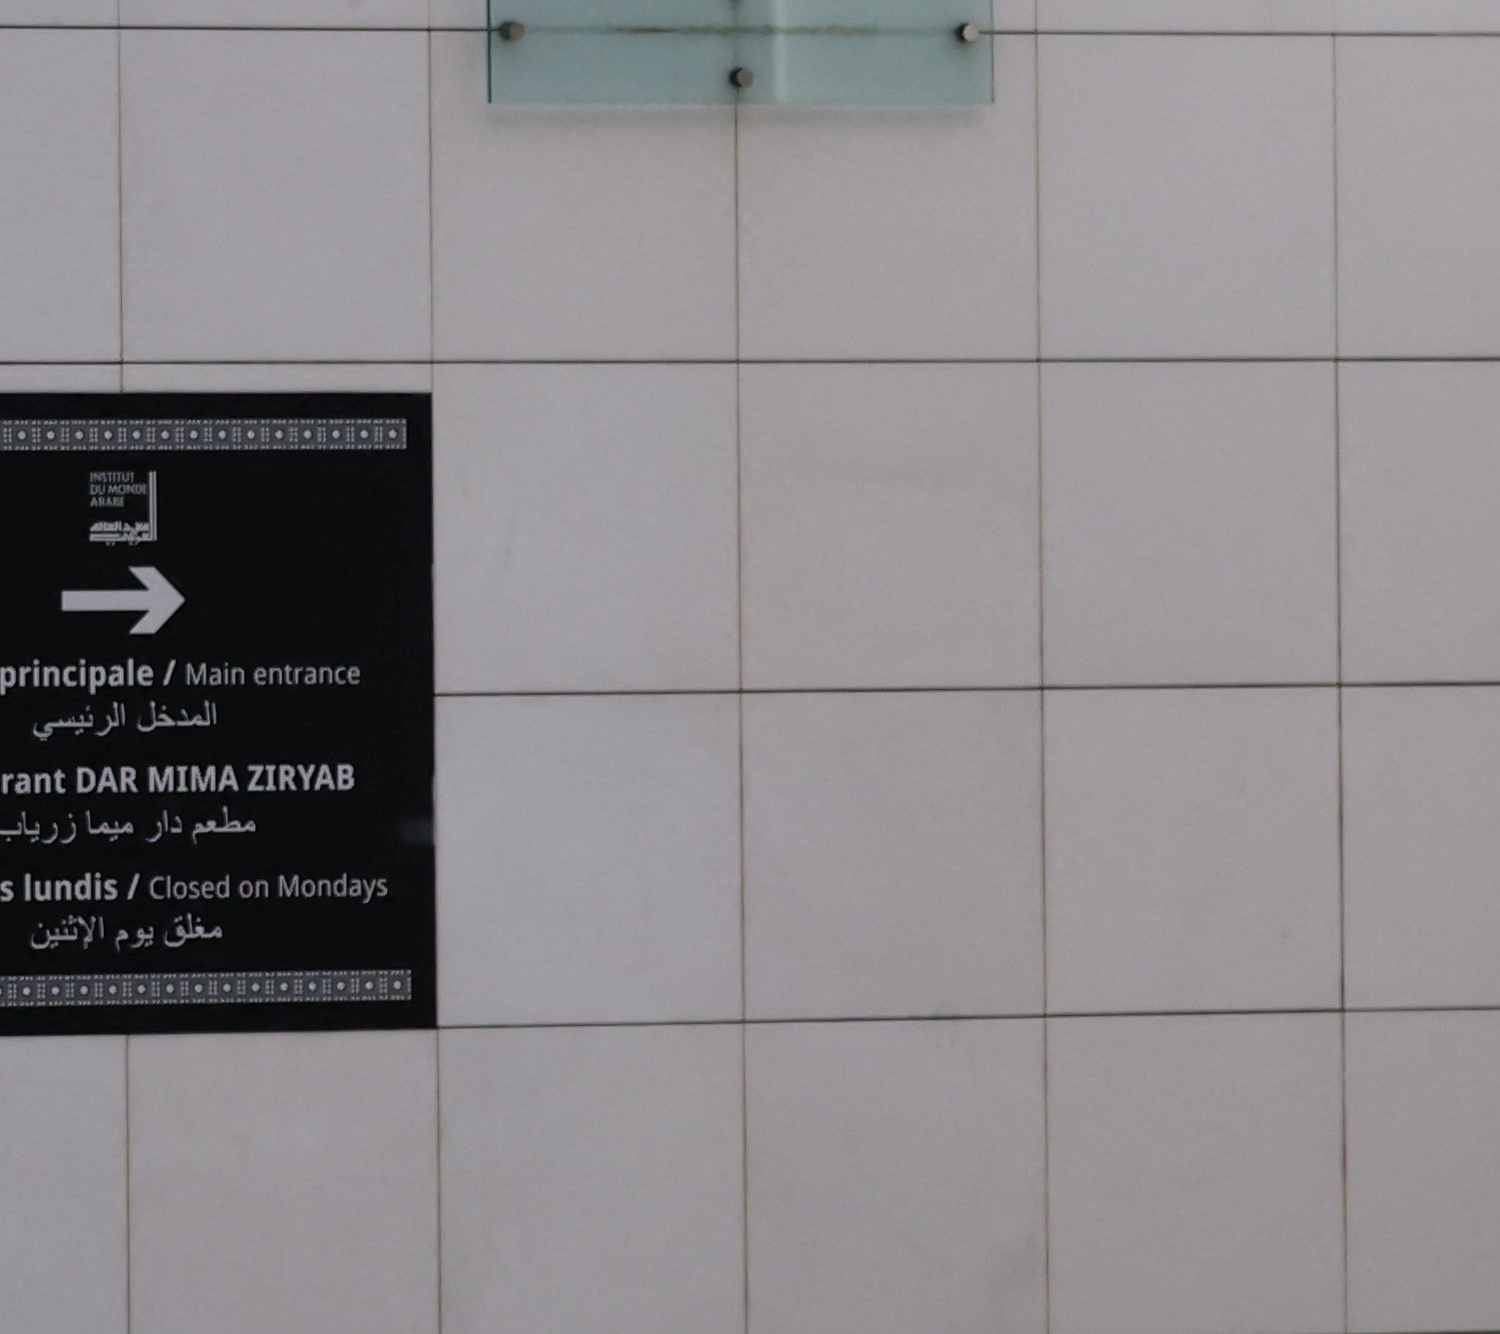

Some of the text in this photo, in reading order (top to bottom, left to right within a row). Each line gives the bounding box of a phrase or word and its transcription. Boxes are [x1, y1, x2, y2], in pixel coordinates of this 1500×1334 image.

[89, 471, 136, 483] INSTITUT
[89, 484, 148, 495] DU MONDE
[163, 658, 176, 687] /
[185, 661, 245, 686] Main
[253, 664, 361, 686] entrance
[32, 699, 217, 742] المدخل الرئيسي
[76, 765, 139, 794] DAR
[147, 764, 240, 793] MIMA
[246, 763, 355, 792] ZIRYAB
[85, 809, 134, 842] ميما
[145, 809, 183, 843] دار
[191, 805, 257, 845] مطعم
[24, 871, 119, 902] lundis
[127, 872, 141, 901] /
[149, 874, 230, 900] Closed
[238, 879, 269, 899] on
[277, 872, 389, 904] Mondays
[115, 925, 155, 952] يوم
[163, 912, 223, 948] مغلق
